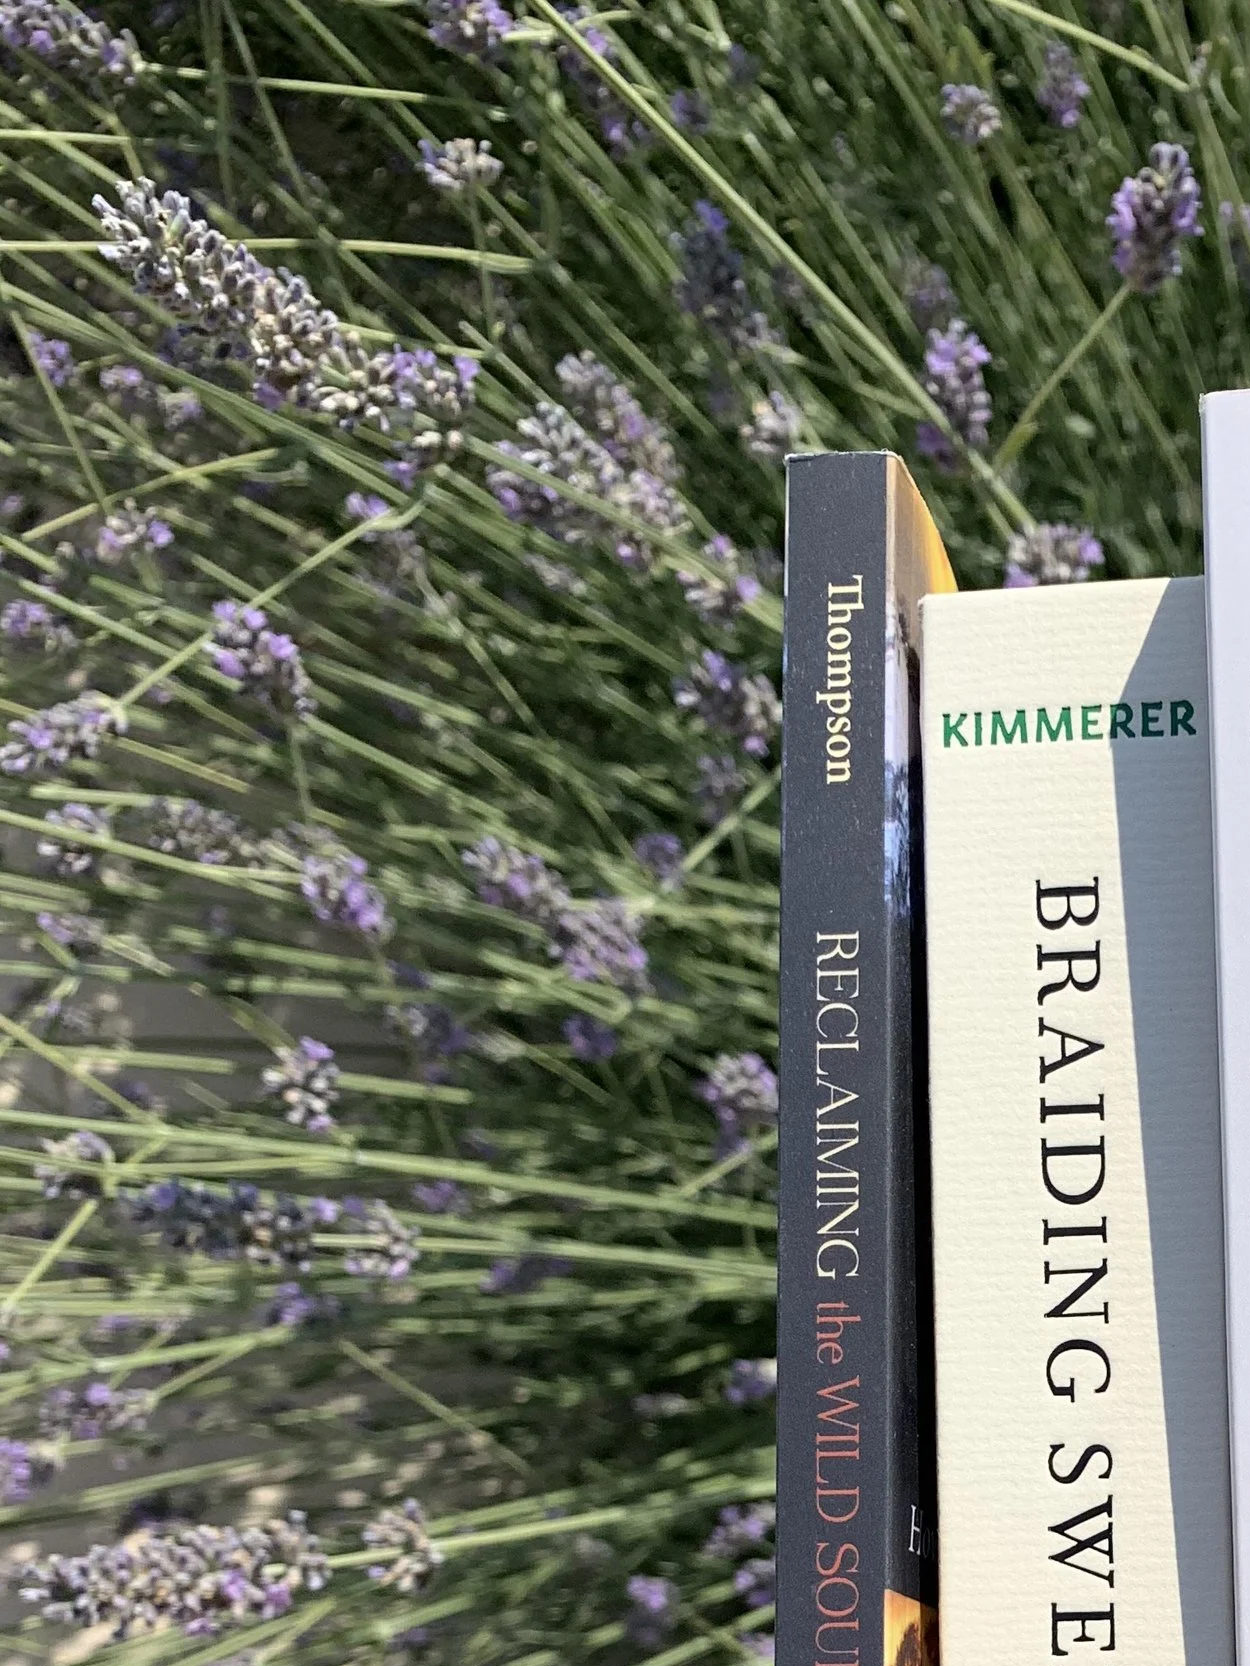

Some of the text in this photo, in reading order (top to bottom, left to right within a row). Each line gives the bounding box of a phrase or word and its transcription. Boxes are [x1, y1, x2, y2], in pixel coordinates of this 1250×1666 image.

[816, 575, 864, 784] Thompson
[942, 699, 1197, 748] KIMMERER
[816, 932, 859, 1279] RECLAIMING
[1036, 876, 1111, 1403] BRAIDING
[817, 1302, 861, 1364] the
[816, 1375, 859, 1522] WILD
